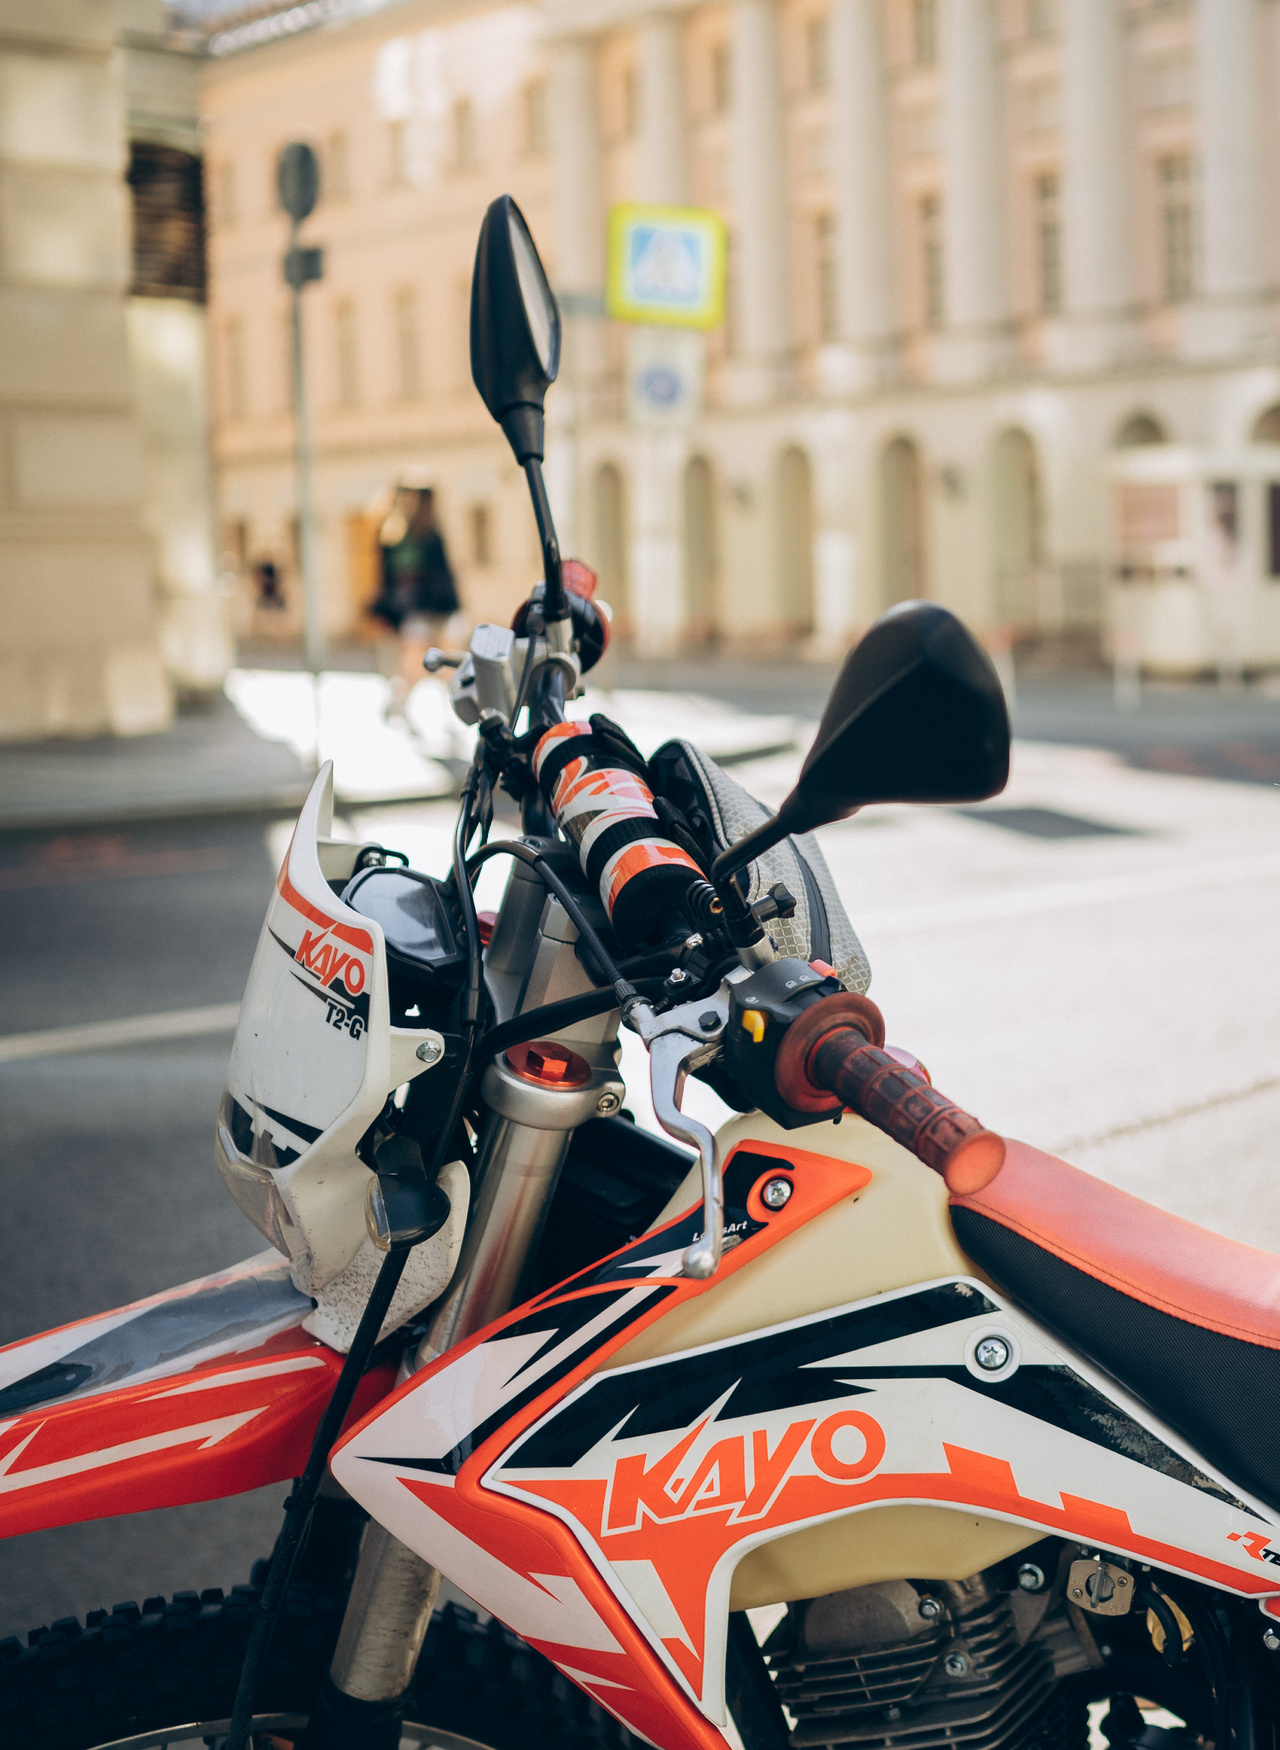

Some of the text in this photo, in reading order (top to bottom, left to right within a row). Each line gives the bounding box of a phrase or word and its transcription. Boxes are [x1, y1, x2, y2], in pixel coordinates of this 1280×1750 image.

[295, 929, 366, 995] KAYO
[326, 1001, 363, 1041] T2-G
[607, 1409, 886, 1530] KAYO
